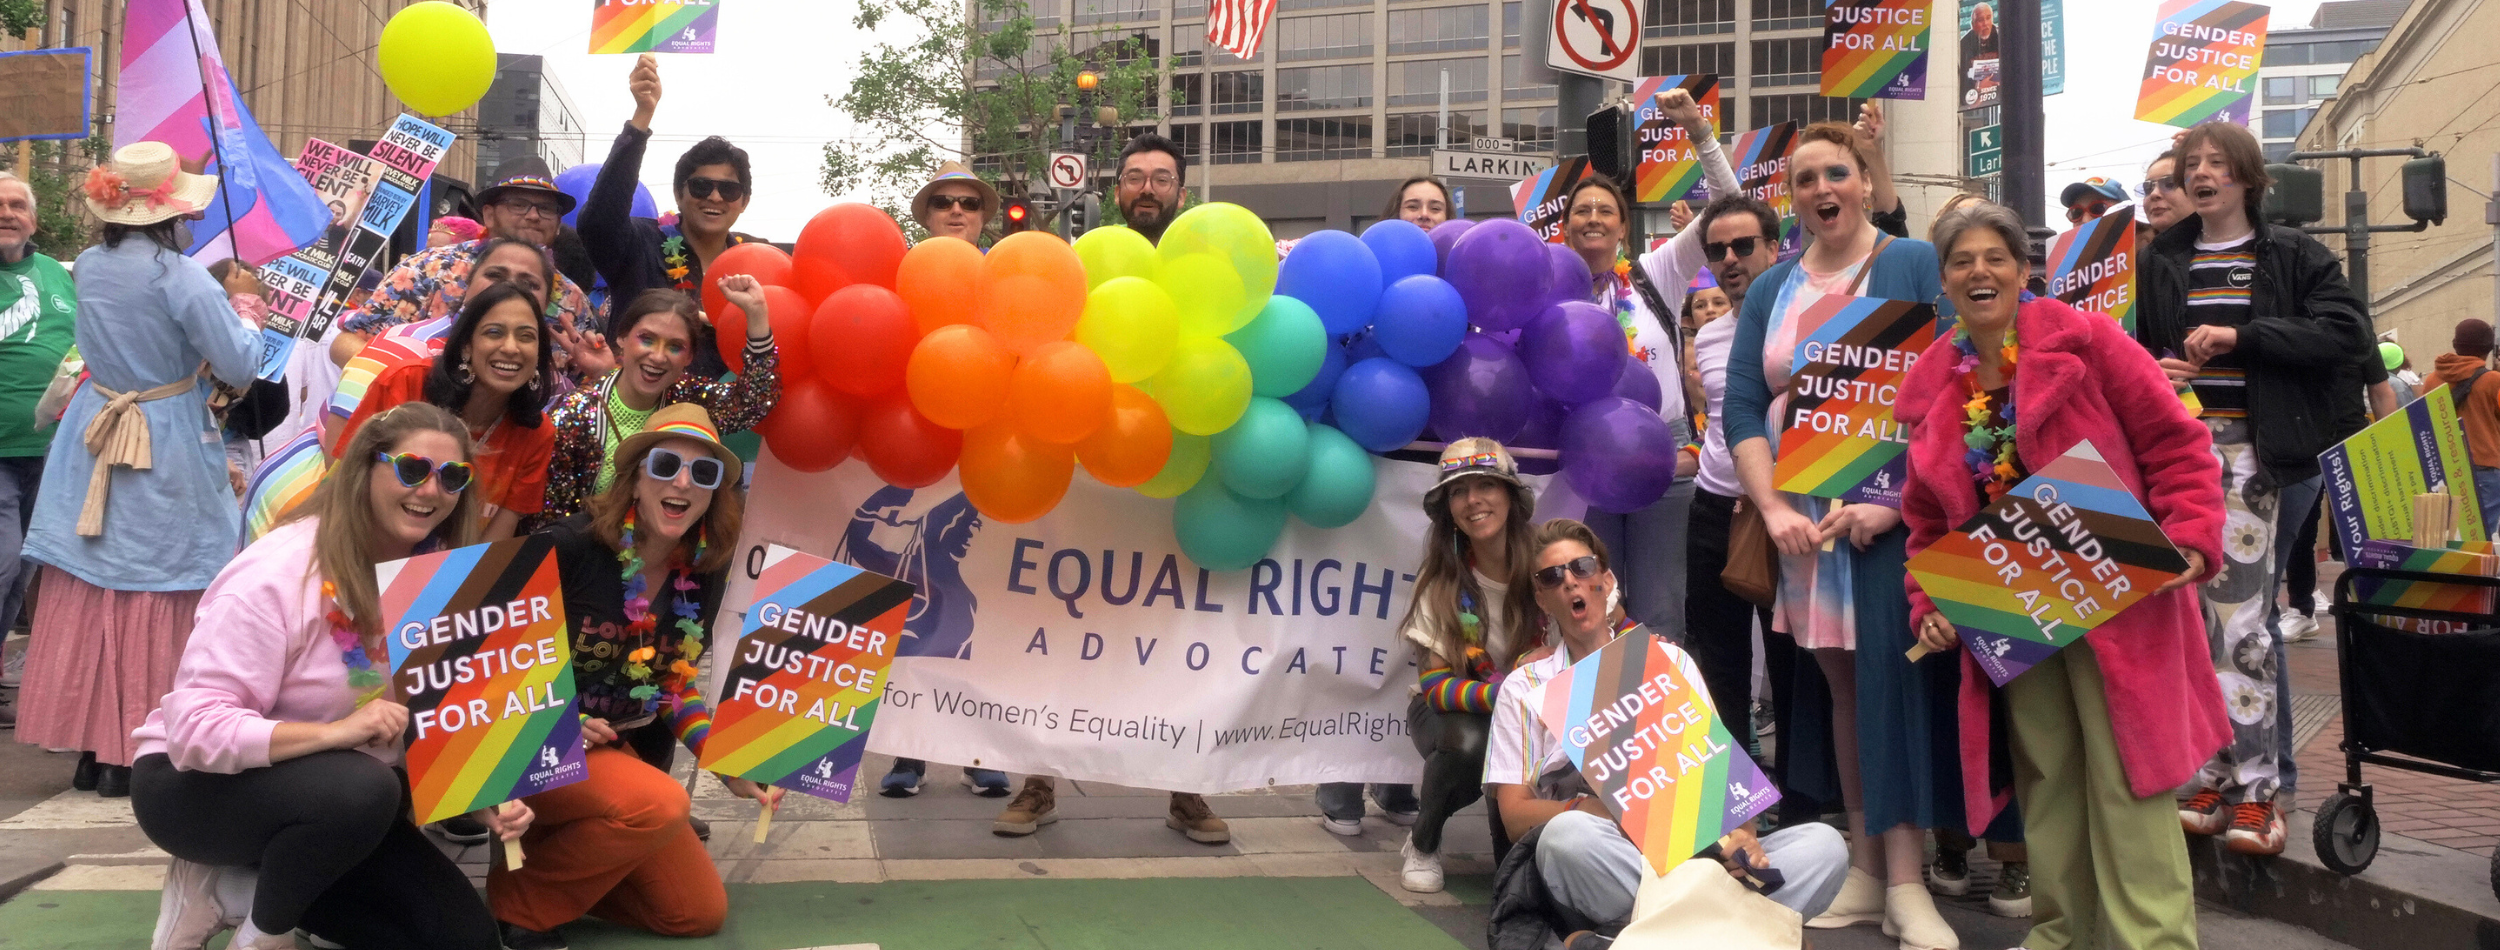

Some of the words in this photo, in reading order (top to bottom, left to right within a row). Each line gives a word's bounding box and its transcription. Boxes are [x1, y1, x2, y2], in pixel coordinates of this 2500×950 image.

[1832, 6, 1924, 25] JUSTICE
[1831, 33, 1875, 50] FOR
[1882, 34, 1921, 52] ALL
[2042, 39, 2057, 57] HE
[2162, 21, 2257, 48] GENDER
[2042, 57, 2058, 76] PLE
[2155, 42, 2254, 70] JUSTICE
[2152, 64, 2199, 86] FOR
[2204, 74, 2246, 94] ALL
[1980, 92, 1997, 103] 1970
[385, 130, 422, 152] NEVER
[421, 142, 439, 160] BE
[396, 118, 423, 138] HOPE
[421, 127, 446, 148] WILL
[1476, 138, 1500, 149] 000
[1640, 126, 1690, 143] JUST
[299, 154, 341, 177] NEVER
[341, 169, 359, 184] BE
[307, 140, 335, 161] WE
[335, 150, 372, 177] WILL
[373, 141, 429, 175] SILENT
[1449, 156, 1534, 176] LARKIN
[1642, 149, 1677, 163] FOR
[385, 166, 403, 181] RVEY
[371, 192, 404, 214] HARVEY
[1524, 195, 1568, 223] GEND
[288, 263, 316, 285] WILL
[347, 252, 366, 268] EATH
[2051, 252, 2129, 297] GENDER
[291, 285, 312, 299] BE
[2070, 284, 2129, 314] STICE
[271, 314, 295, 329] MILK
[312, 313, 327, 331] AR
[1803, 340, 1919, 374] GENDER
[1797, 374, 1897, 407] JUSTIC
[1793, 408, 1850, 436] FOR
[1857, 418, 1909, 444] ALL
[2437, 396, 2459, 464] resources
[2420, 430, 2431, 459] RIGHTS
[2370, 433, 2391, 497] discrimination
[2388, 450, 2406, 502] harassment
[2408, 471, 2417, 487] pay
[2427, 457, 2438, 483] EQUAL
[2453, 467, 2463, 479] &
[1862, 487, 1881, 496] EQUAL
[1883, 490, 1902, 498] RIGHT
[2327, 451, 2354, 512] Rights!
[2359, 448, 2380, 513] discrimination
[2459, 480, 2477, 526] guides
[2401, 503, 2413, 534] Sexual
[2033, 482, 2132, 601] GENDER
[2346, 515, 2364, 559] Your
[2000, 502, 2101, 620] JUSTICE
[1007, 537, 1223, 619] EQUAL
[1248, 558, 1417, 620] RIGH
[1968, 524, 2023, 586] FOR
[2014, 588, 2064, 641] ALL
[400, 596, 552, 650] GENDER
[758, 602, 887, 657] GENDER
[405, 637, 558, 696] JUSTICE
[744, 639, 878, 694] JUSTICE
[1975, 635, 1992, 656] EQUAL
[1990, 655, 2009, 677] RIGHTS
[414, 698, 492, 740] FOR
[502, 681, 565, 720] ALL
[734, 677, 798, 715] FOR
[804, 698, 860, 732] ALL
[883, 681, 923, 710] for
[934, 688, 1058, 730] Women's
[1069, 708, 1186, 750] Equality
[1215, 711, 1411, 747] www.EqualRight
[1568, 672, 1680, 749] GENDER
[1588, 700, 1703, 783] JUSTICE
[530, 769, 553, 782] EQUAL
[554, 761, 581, 775] RIGHTS
[801, 774, 822, 785] EQUAL
[823, 780, 847, 792] RIGHTS
[1612, 765, 1675, 812] FOR
[1675, 734, 1728, 776] ALL
[1730, 799, 1750, 815] EQUAL
[1749, 786, 1771, 803] RIGHTS
